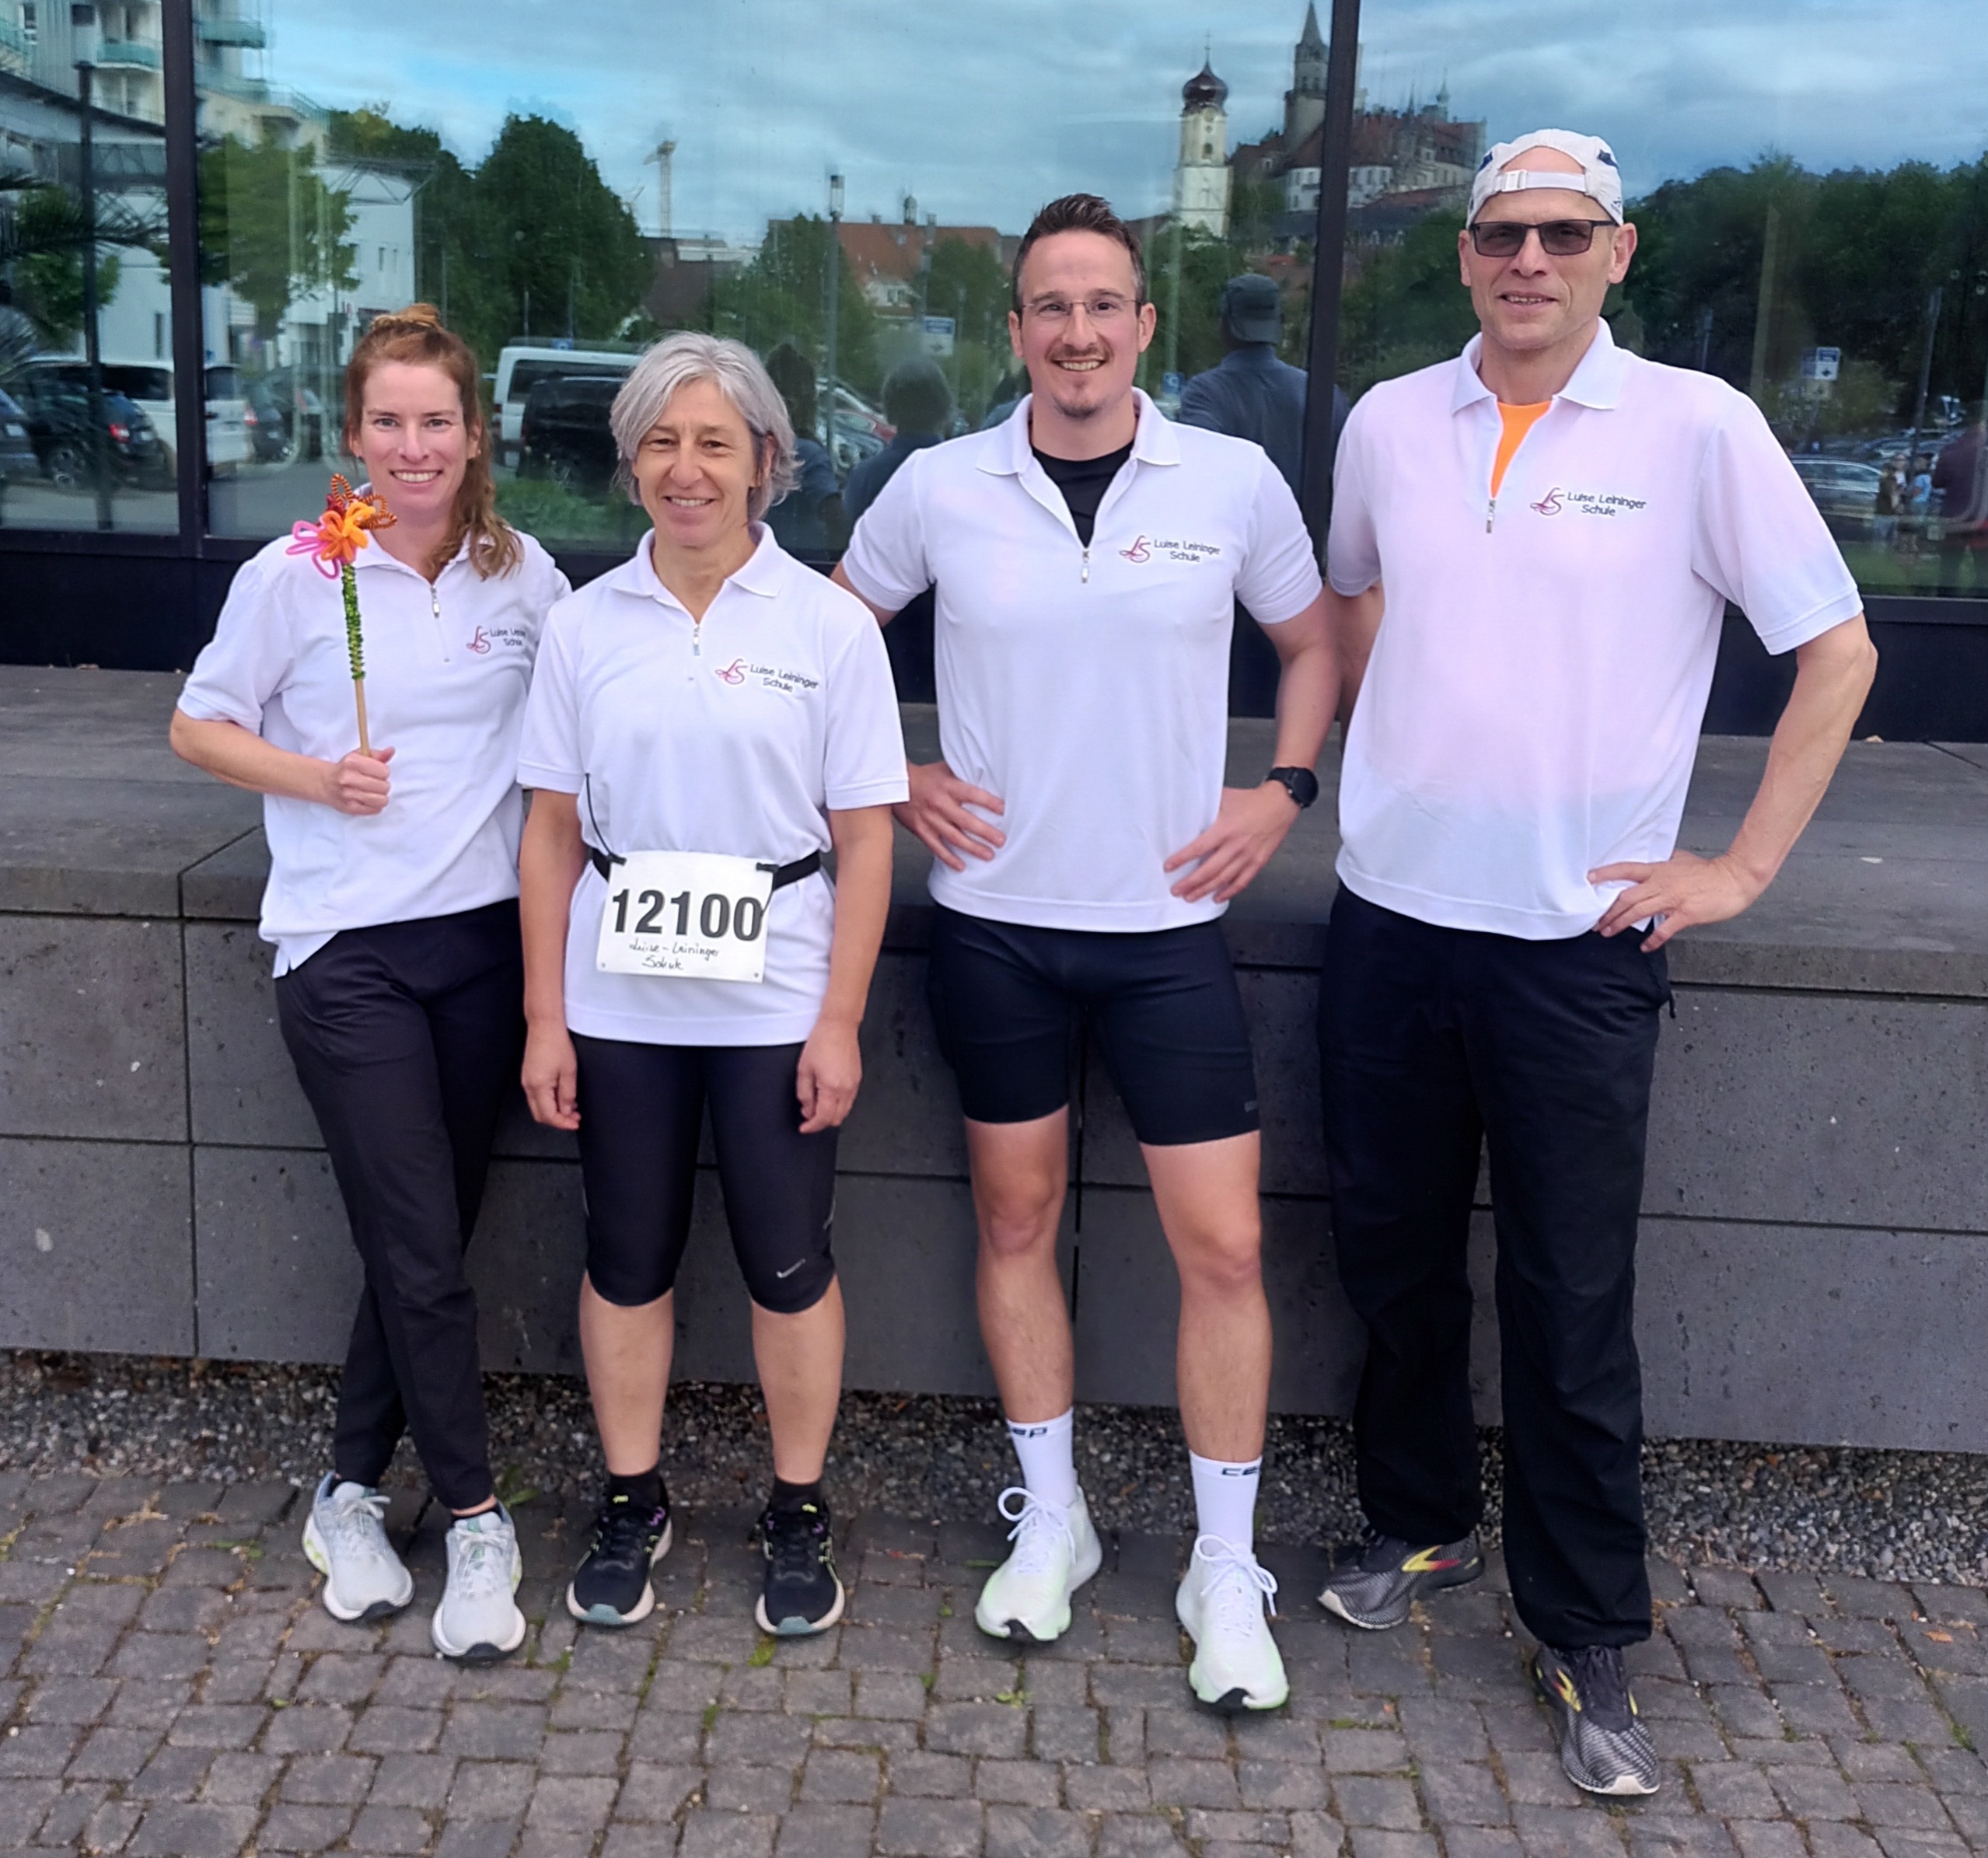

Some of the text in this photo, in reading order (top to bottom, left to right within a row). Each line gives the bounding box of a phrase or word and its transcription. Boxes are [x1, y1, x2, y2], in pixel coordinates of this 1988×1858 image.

[1567, 491, 1647, 509] Luise Leininger
[1581, 504, 1616, 516] Schule
[1154, 539, 1180, 550] Luise
[1169, 550, 1201, 563] Schule
[749, 663, 819, 690] Luise Leininger
[762, 676, 793, 693] Schule
[613, 889, 763, 942] 12100
